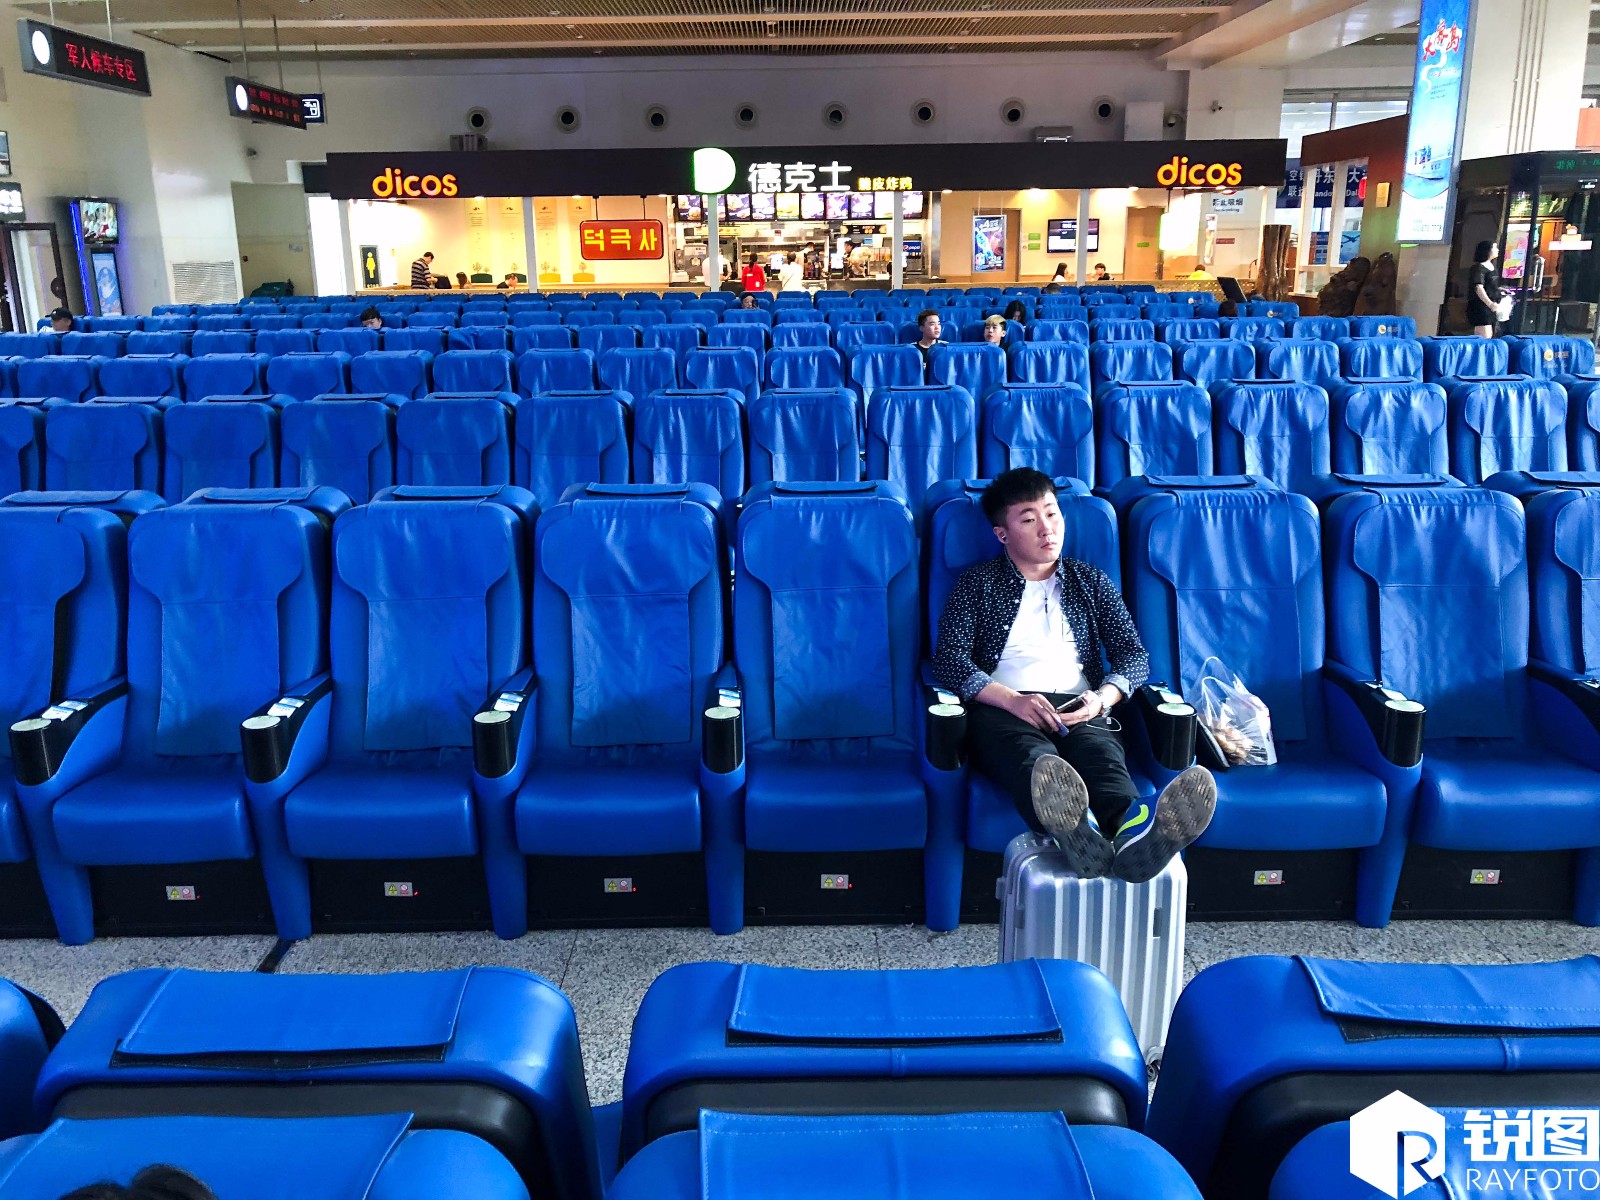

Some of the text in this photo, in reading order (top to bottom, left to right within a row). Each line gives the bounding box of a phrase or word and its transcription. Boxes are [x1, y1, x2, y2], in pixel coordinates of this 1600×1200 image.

[372, 168, 458, 197] dicos
[748, 161, 852, 193] 德克士
[1157, 156, 1242, 186] dicos
[584, 228, 658, 252] 덕극사
